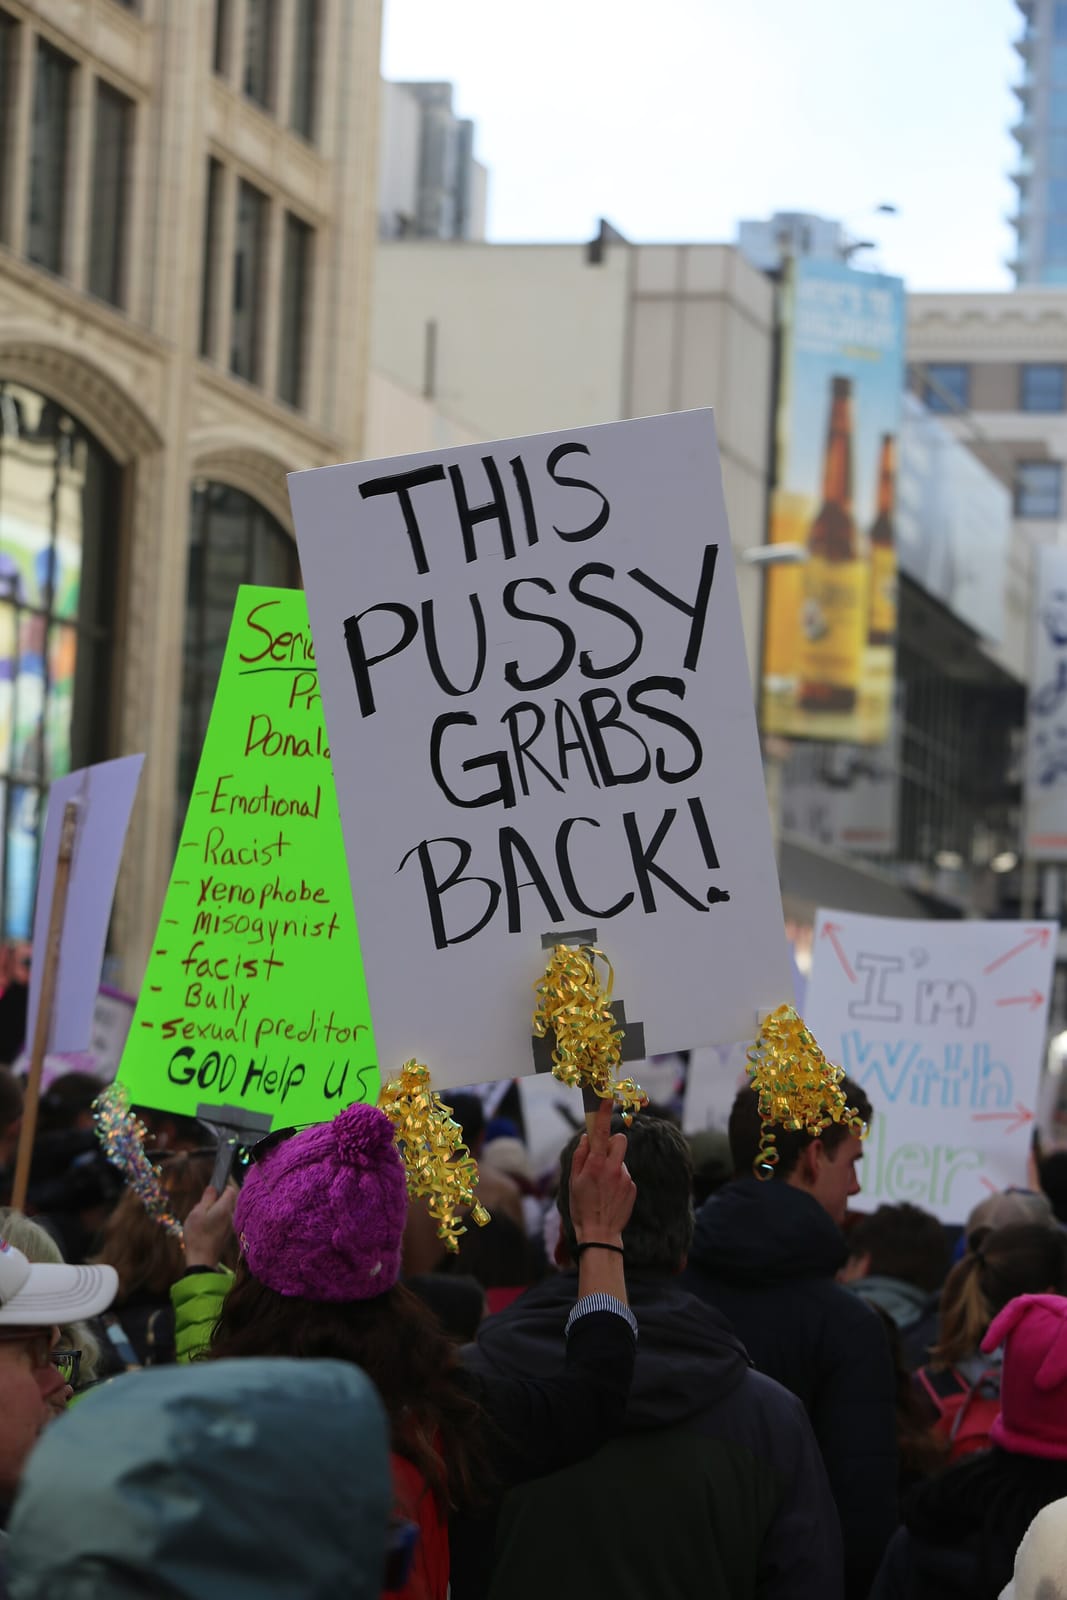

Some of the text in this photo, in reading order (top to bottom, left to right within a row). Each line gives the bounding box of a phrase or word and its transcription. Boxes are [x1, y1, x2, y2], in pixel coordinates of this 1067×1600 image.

[359, 443, 609, 574] THIS
[344, 544, 718, 718] PUSSY
[430, 676, 702, 809] GRABS
[210, 775, 321, 819] Emotional
[204, 826, 291, 867] Racist
[397, 797, 730, 949] BACK!
[181, 940, 284, 981] facist
[848, 947, 978, 1029] I'm
[161, 1017, 247, 1042] sexual
[255, 1010, 368, 1048] preditor
[185, 982, 249, 1026] Bully
[168, 1046, 236, 1093] GOD
[239, 1055, 305, 1104] Help
